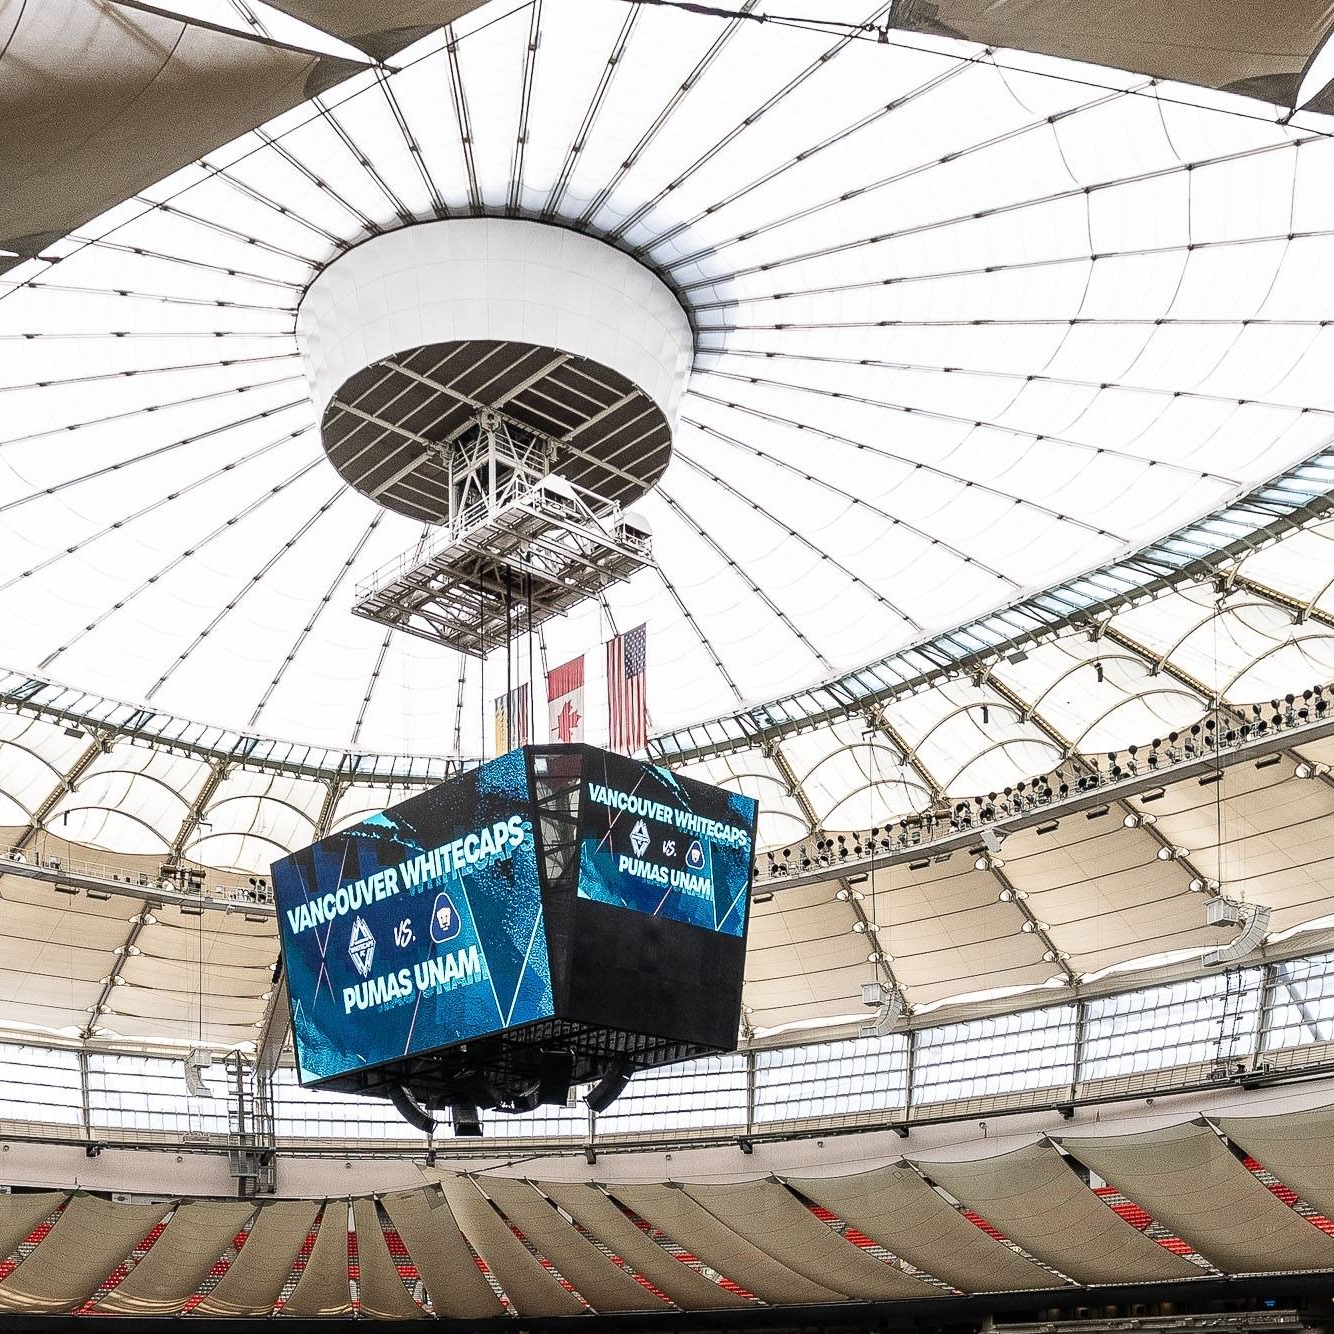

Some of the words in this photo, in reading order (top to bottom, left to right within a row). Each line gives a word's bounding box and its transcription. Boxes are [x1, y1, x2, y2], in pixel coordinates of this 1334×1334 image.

[589, 783, 673, 824] VANCOUVER
[674, 808, 748, 846] WHITECAPS
[662, 839, 676, 856] VS.
[286, 868, 399, 935] VANCOUVER
[399, 815, 525, 890] WHITECAPS
[618, 855, 669, 884] PUMAS
[670, 868, 713, 898] UNAM
[393, 918, 416, 947] VS.
[343, 968, 413, 1014] PUMAS
[413, 945, 483, 992] UNAM
